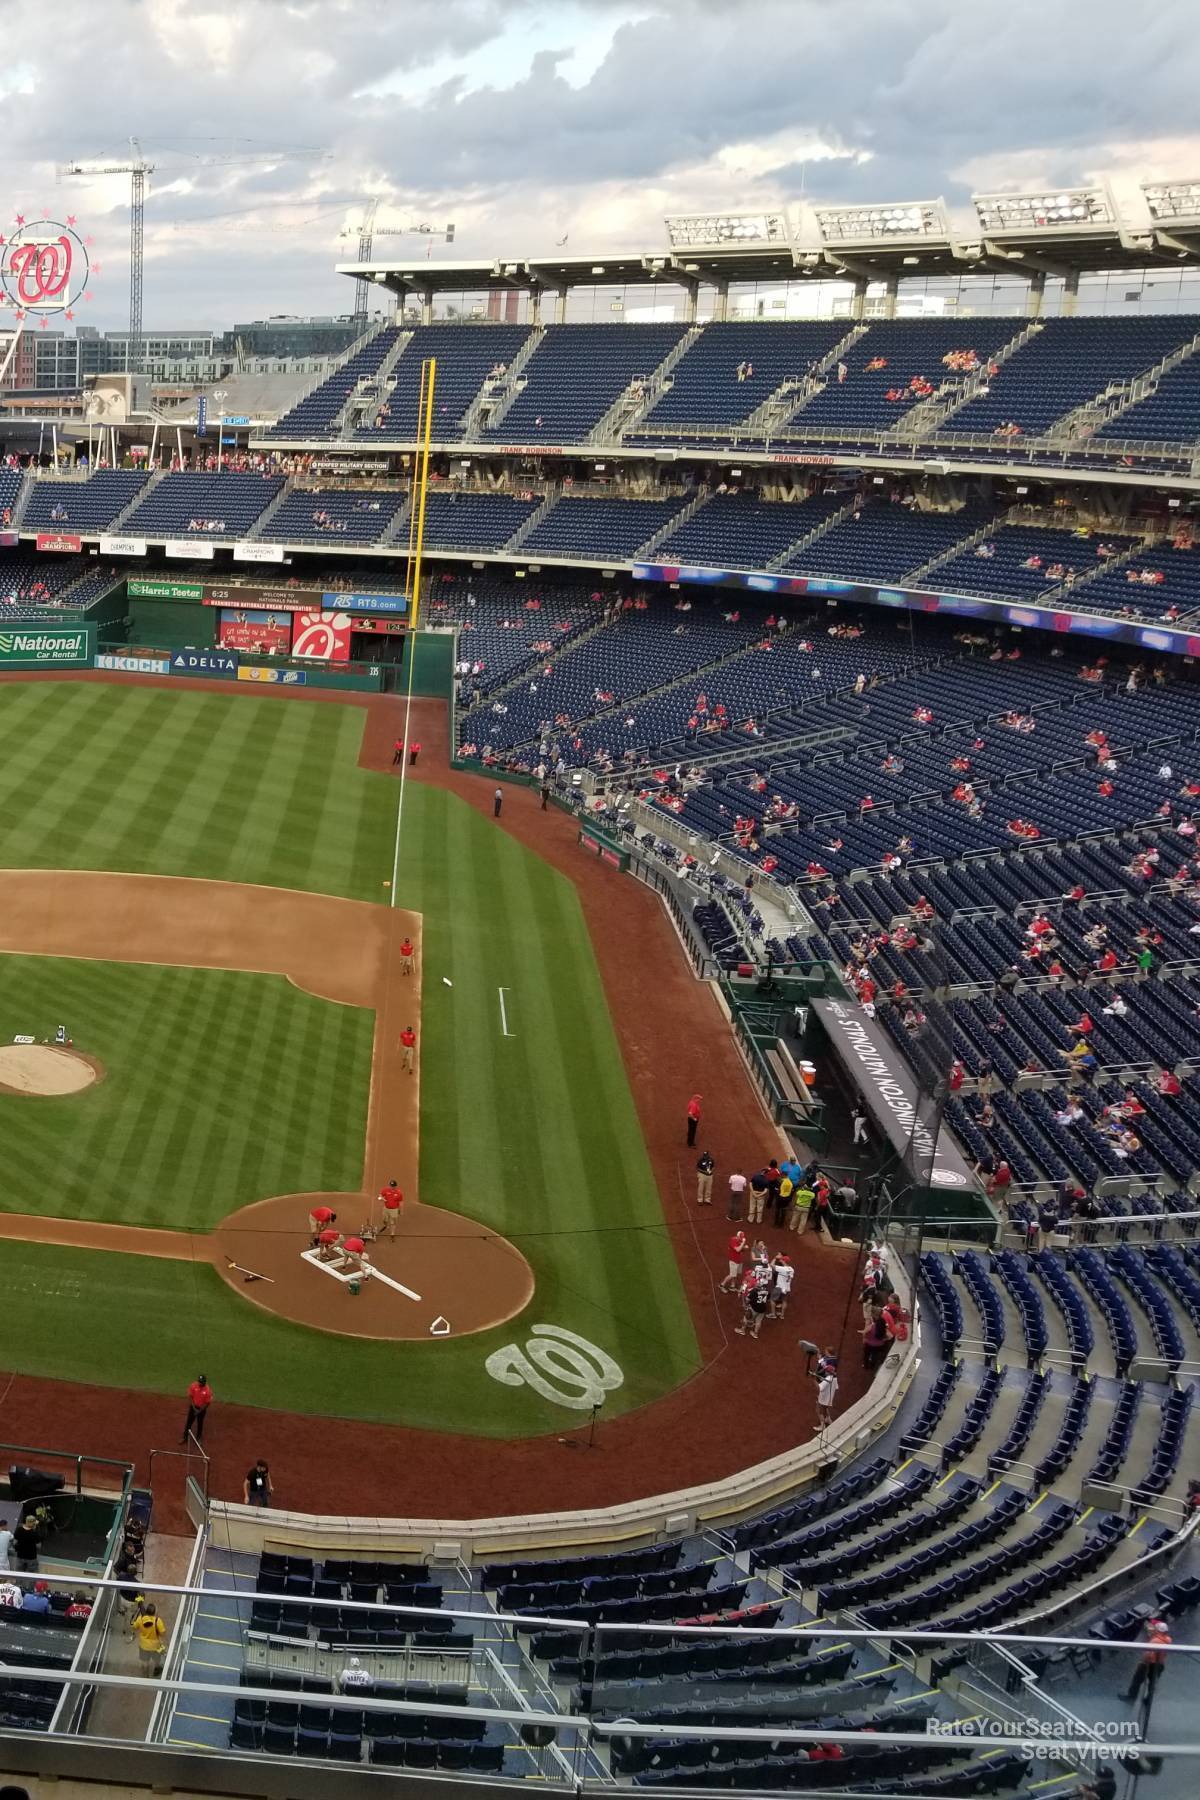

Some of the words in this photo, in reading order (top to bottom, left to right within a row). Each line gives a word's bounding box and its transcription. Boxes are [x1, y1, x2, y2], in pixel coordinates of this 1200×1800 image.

[800, 456, 835, 464] HOWARD
[141, 583, 169, 594] Harris
[171, 588, 200, 597] Teeter
[211, 590, 229, 598] 6:25
[36, 651, 49, 659] Car
[52, 651, 78, 659] Rental
[114, 656, 166, 673] KOCH
[189, 656, 235, 669] DELTA
[369, 666, 379, 676] 335
[838, 1020, 893, 1076] NATIONALS
[873, 1077, 944, 1157] WASHINGTON
[756, 1295, 767, 1304] 34
[0, 1595, 14, 1606] 34
